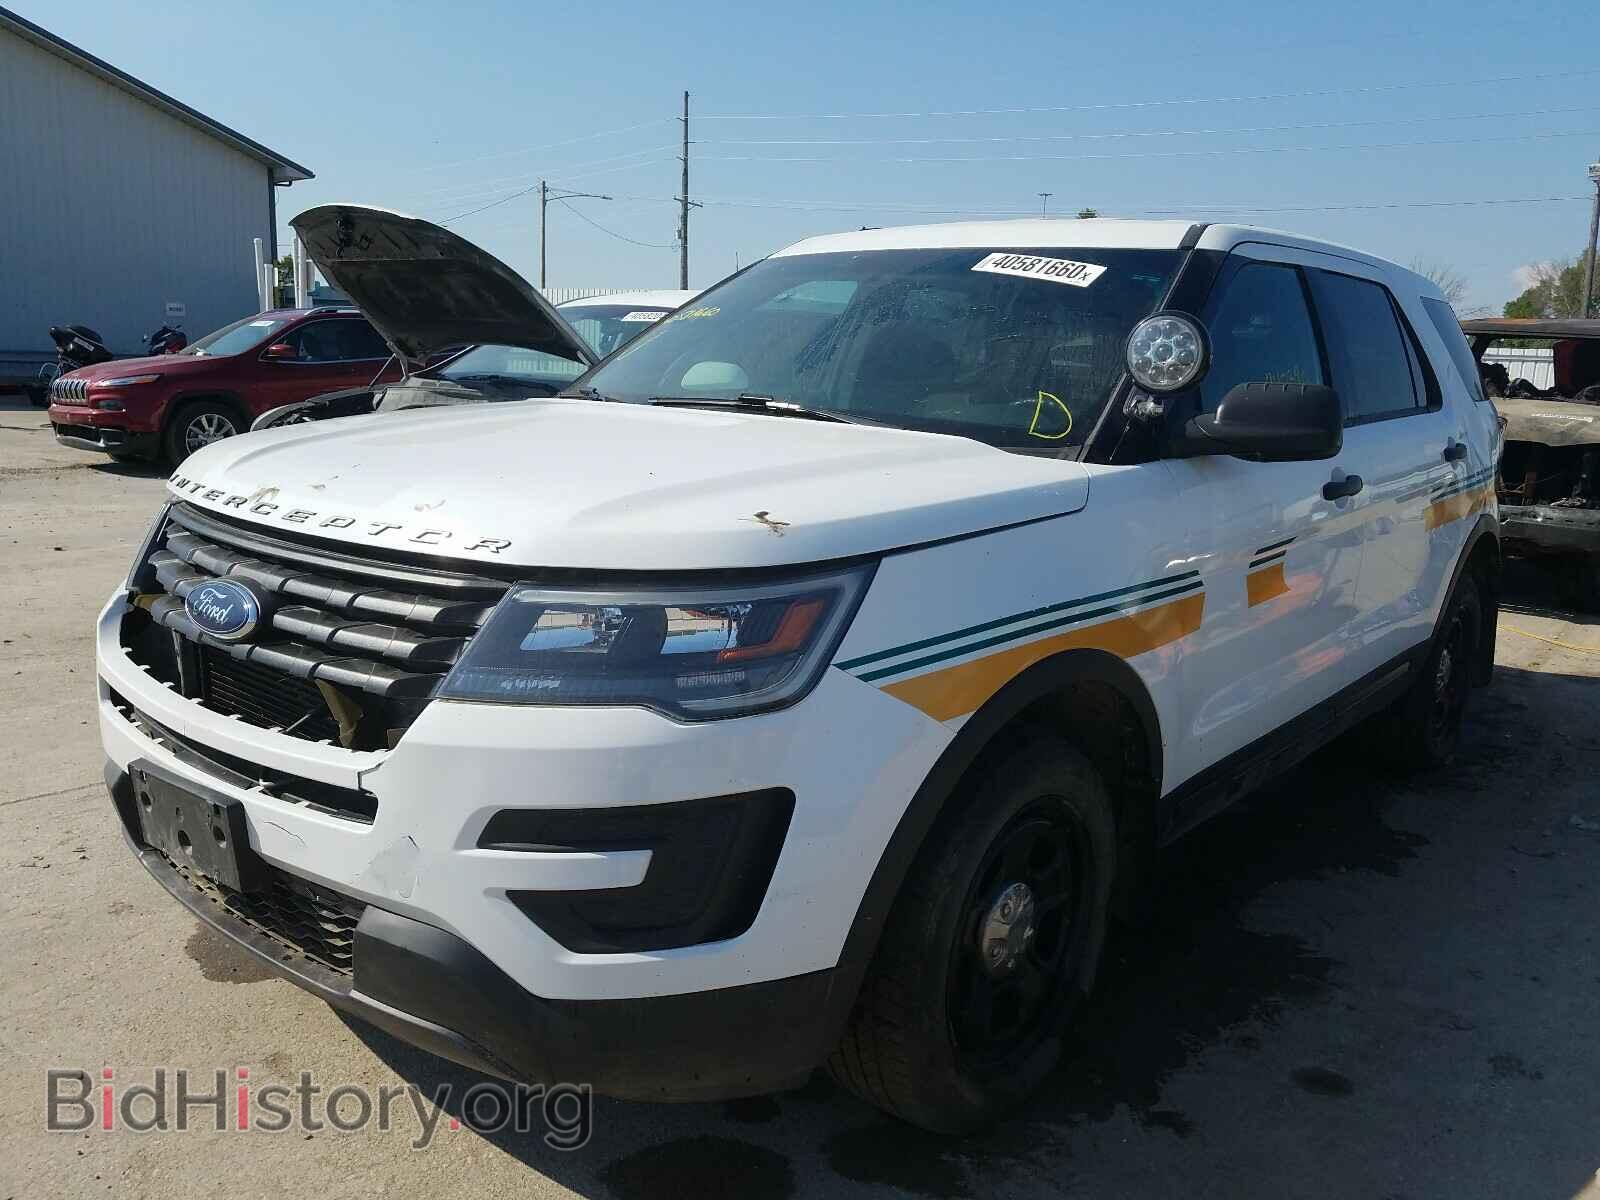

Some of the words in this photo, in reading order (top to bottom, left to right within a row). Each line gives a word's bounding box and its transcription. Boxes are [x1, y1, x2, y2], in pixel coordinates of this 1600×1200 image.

[1028, 390, 1072, 439] D
[168, 474, 512, 554] INTERCEPTOR
[193, 587, 234, 625] Ford
